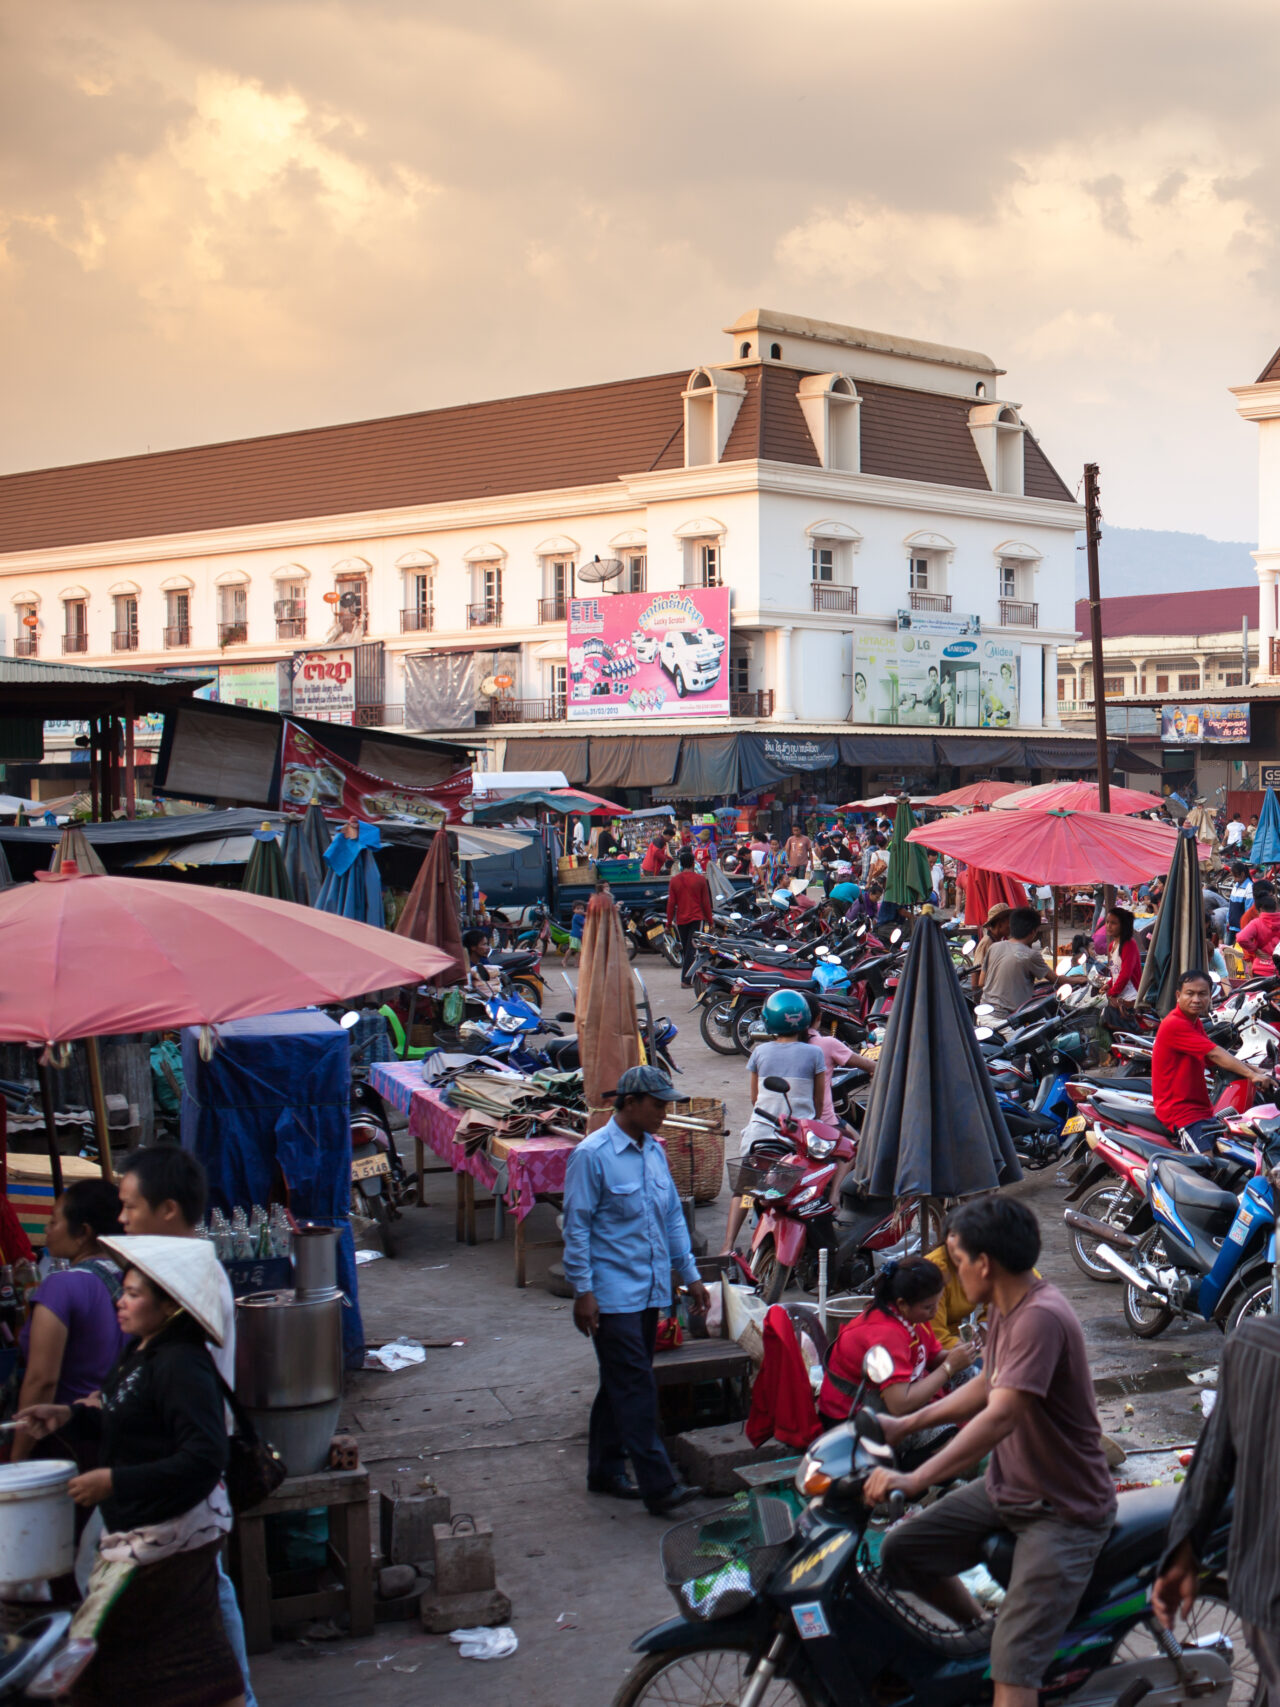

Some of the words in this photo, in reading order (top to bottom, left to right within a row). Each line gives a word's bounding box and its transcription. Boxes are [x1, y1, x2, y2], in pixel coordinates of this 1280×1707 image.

[571, 600, 605, 621] ETL
[859, 635, 896, 648] HITACHI
[917, 639, 931, 651] LG
[946, 644, 975, 654] SAMSUNG
[990, 645, 1014, 657] Midea
[798, 1199, 822, 1213] SUZUKI
